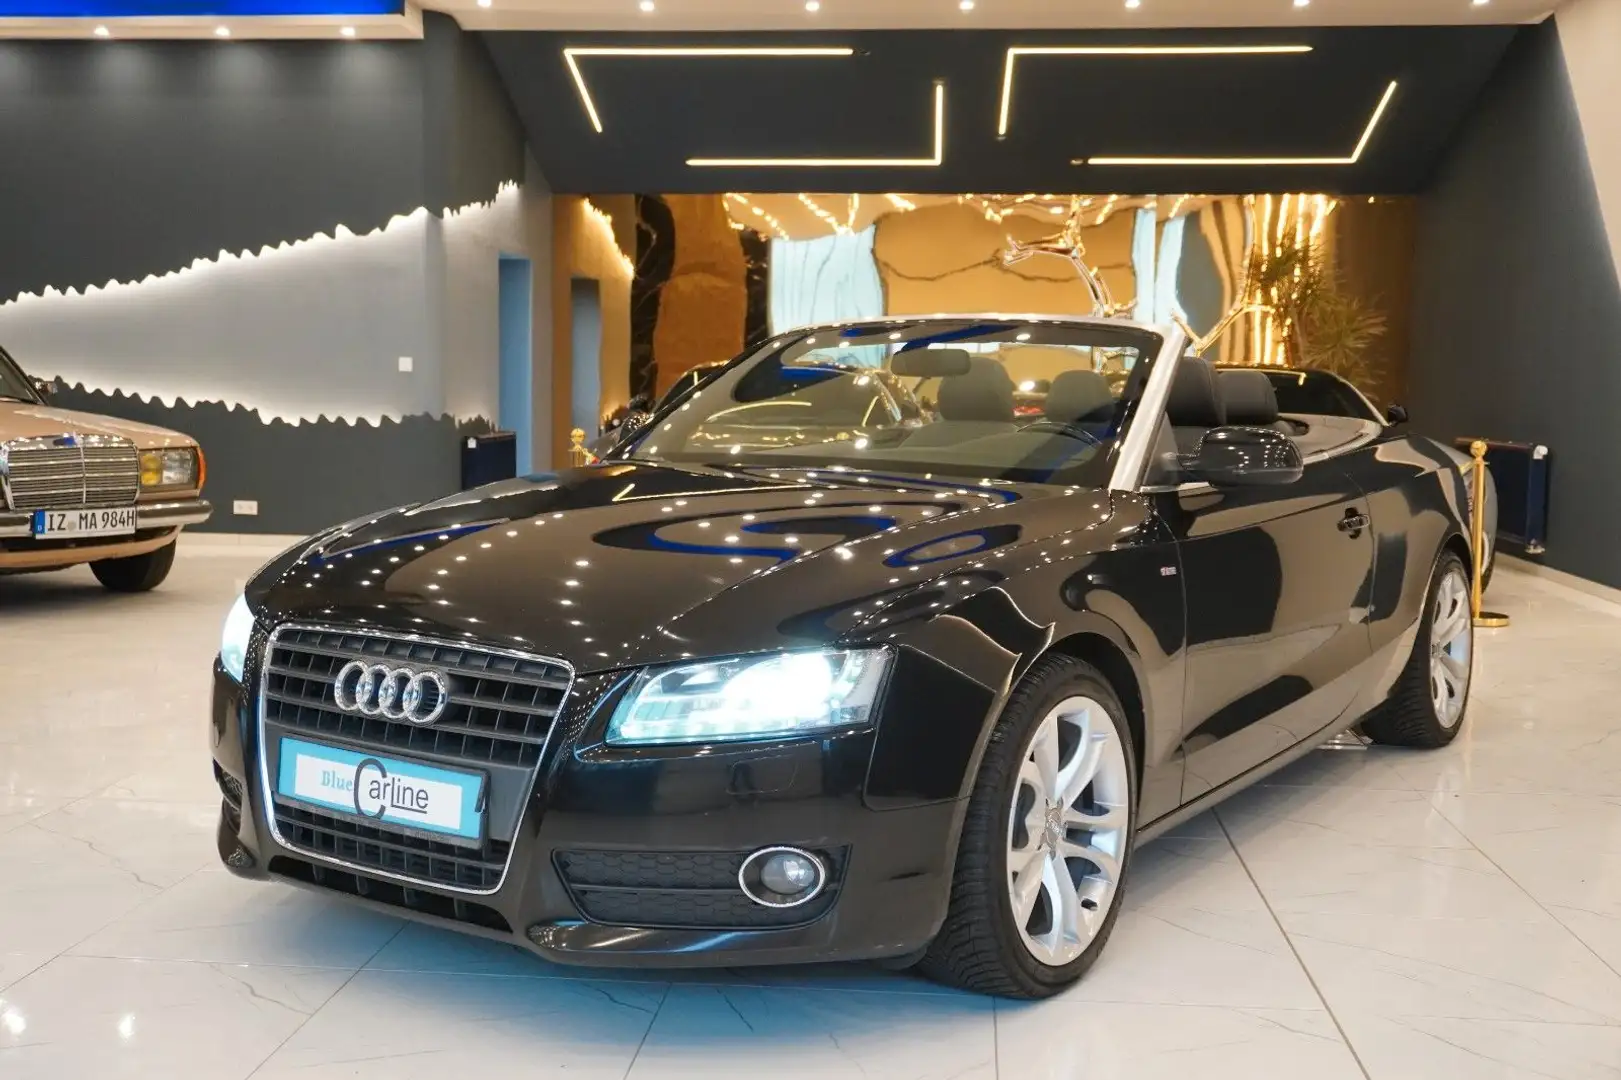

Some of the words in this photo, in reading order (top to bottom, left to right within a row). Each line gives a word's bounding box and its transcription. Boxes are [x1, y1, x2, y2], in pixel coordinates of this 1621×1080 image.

[47, 513, 67, 532] IZ
[78, 512, 98, 530] MA
[101, 510, 135, 529] 984H
[321, 769, 353, 792] Blue
